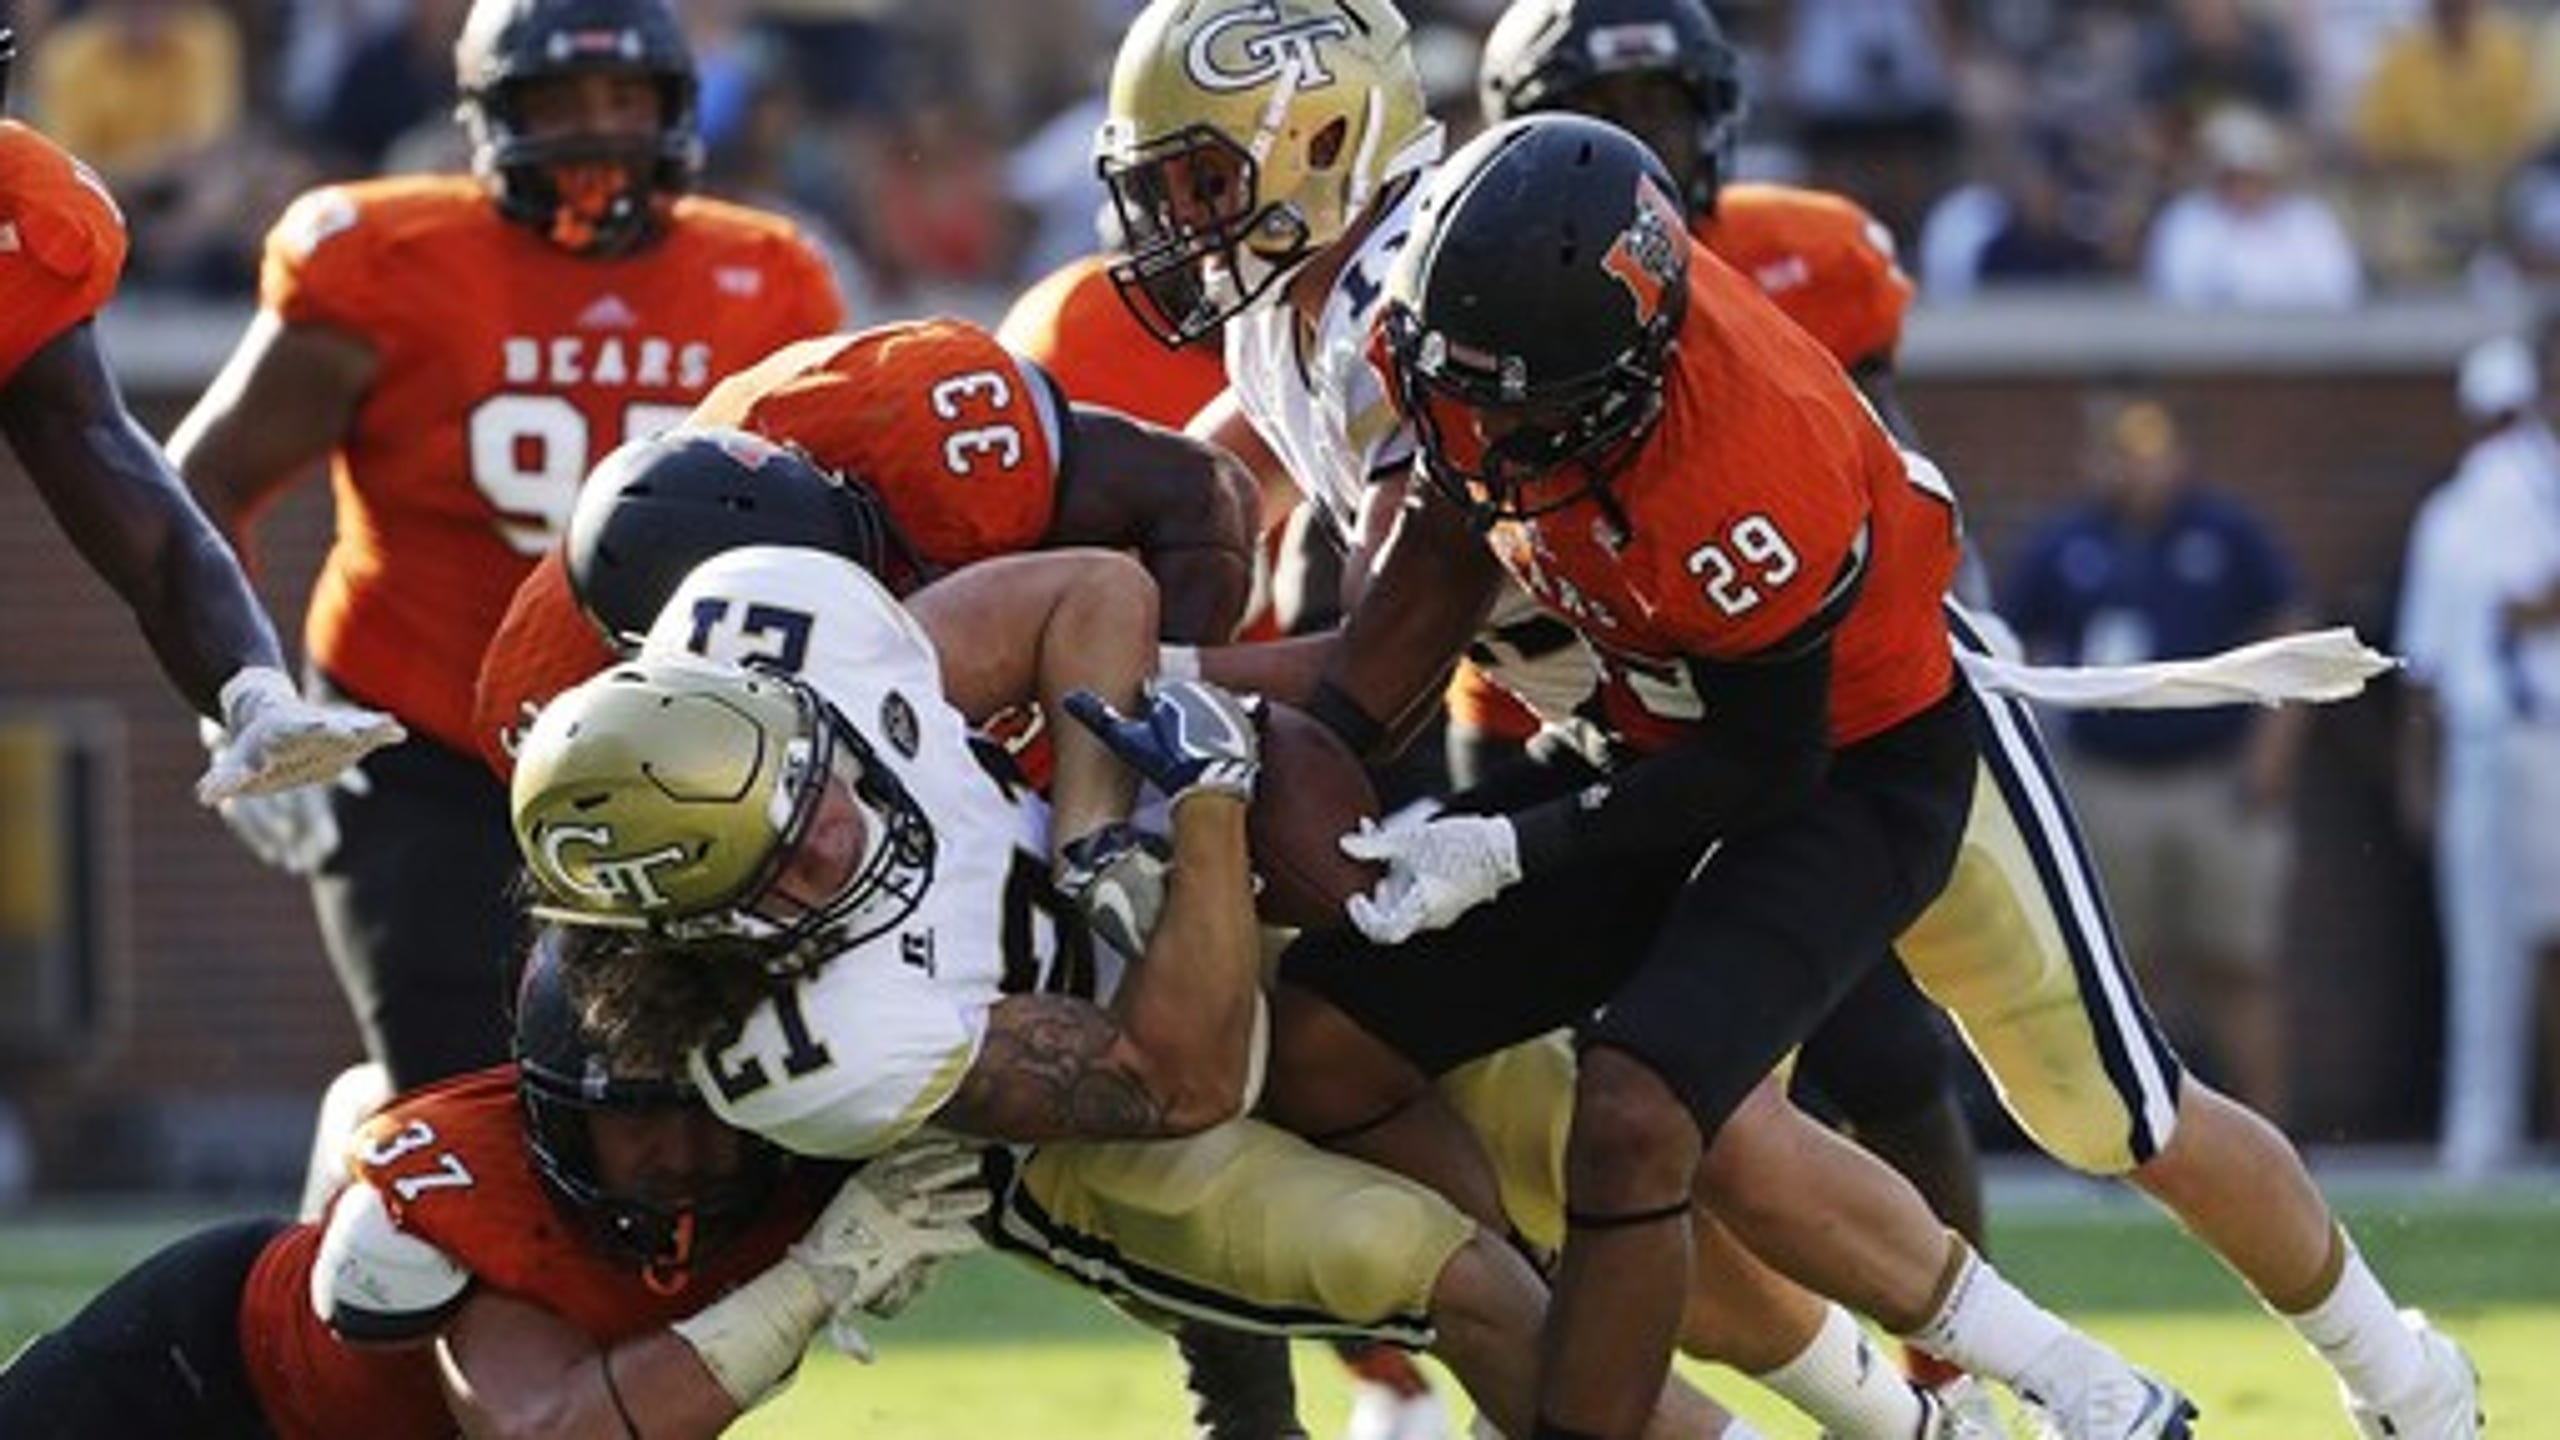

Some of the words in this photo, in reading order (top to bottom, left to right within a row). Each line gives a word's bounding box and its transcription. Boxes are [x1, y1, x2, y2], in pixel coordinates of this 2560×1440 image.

[503, 336, 712, 389] BEARS
[932, 369, 1020, 474] 33
[1687, 513, 1801, 617] 29
[545, 826, 684, 909] GT
[358, 1118, 475, 1201] 37
